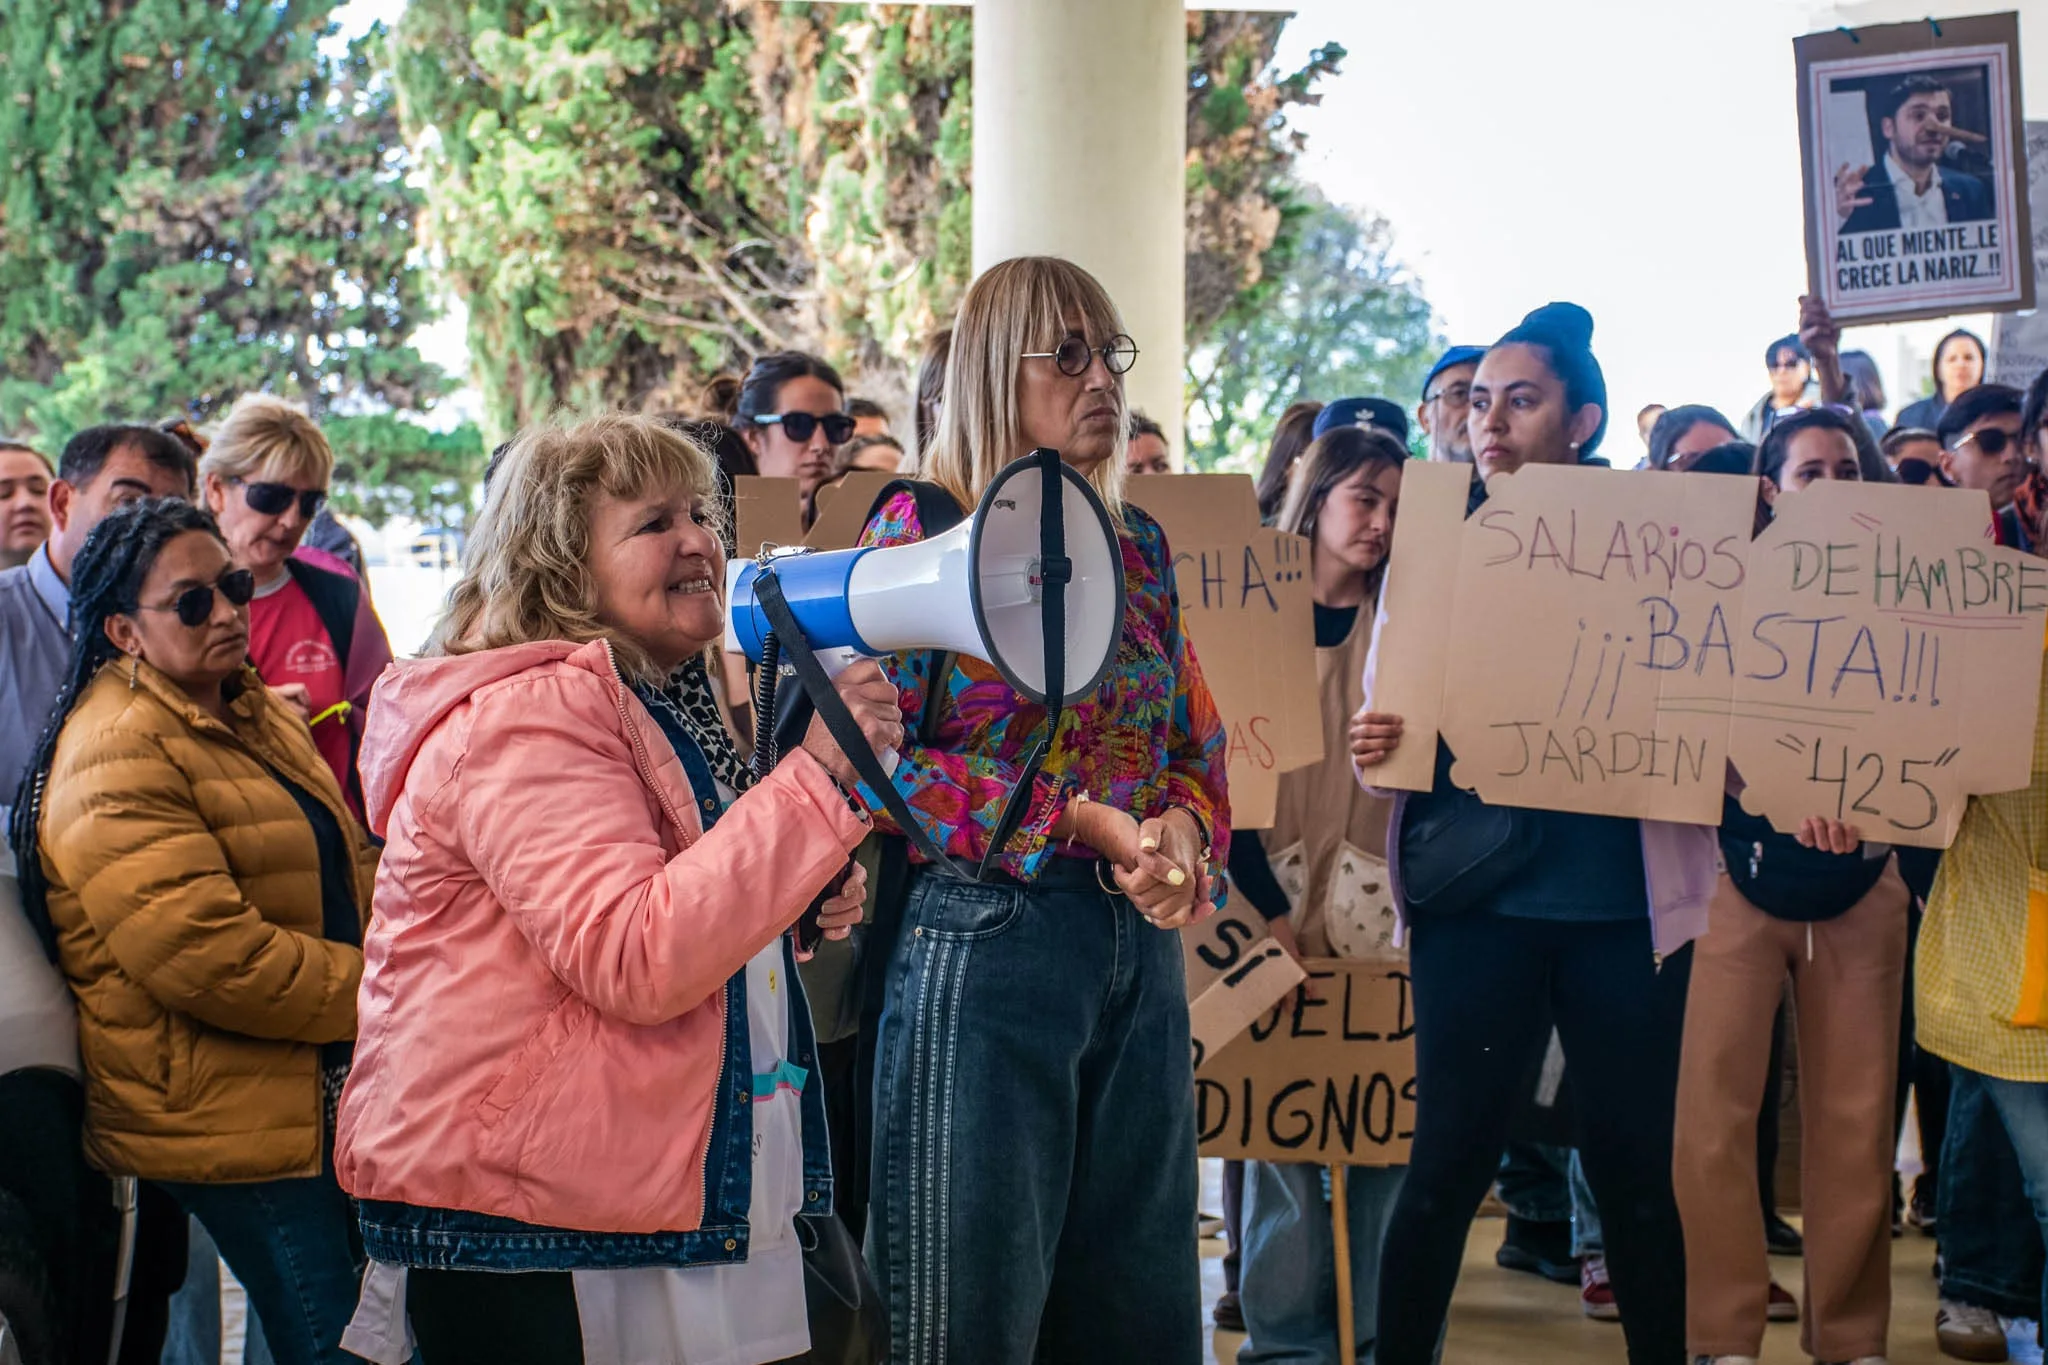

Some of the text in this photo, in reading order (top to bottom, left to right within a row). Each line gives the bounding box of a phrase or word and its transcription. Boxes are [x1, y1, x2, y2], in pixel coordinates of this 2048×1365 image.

[1837, 239, 1859, 263] AL
[1863, 233, 1897, 261] QUE
[1838, 263, 1892, 291] CRECE
[1898, 260, 1920, 284] LA
[1774, 540, 1860, 597] DE
[1489, 721, 1706, 786] JARDIN
